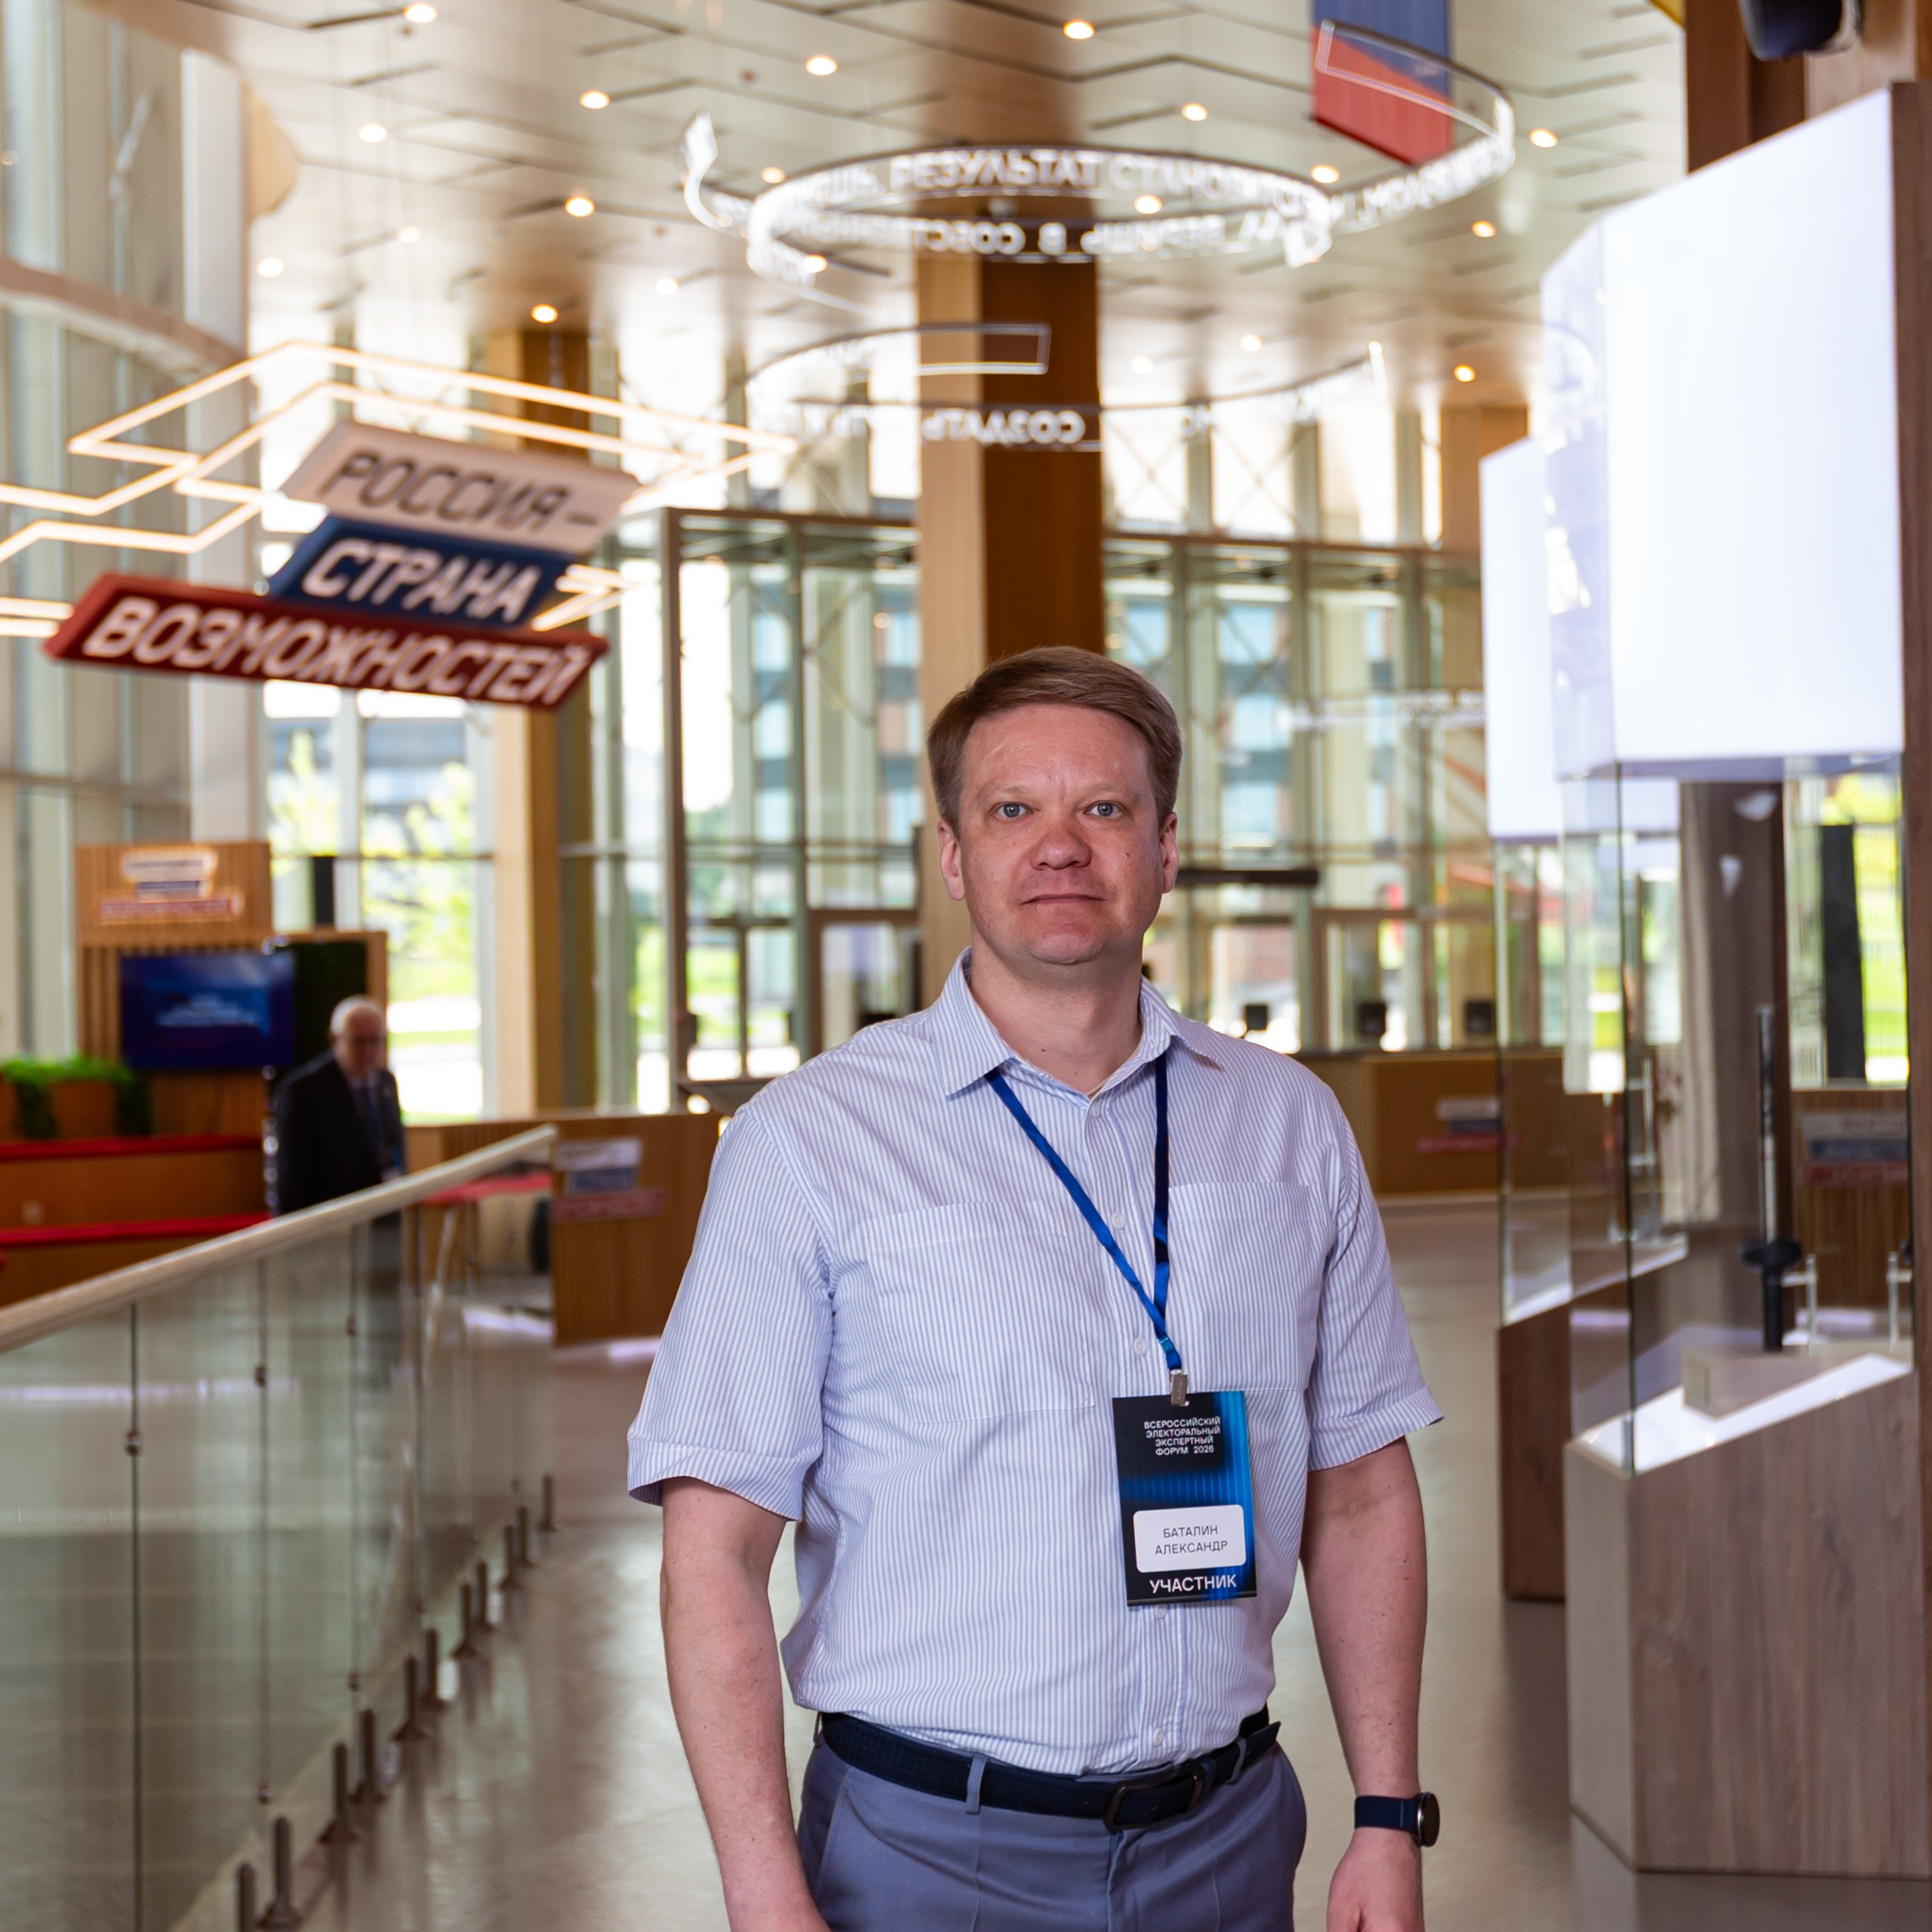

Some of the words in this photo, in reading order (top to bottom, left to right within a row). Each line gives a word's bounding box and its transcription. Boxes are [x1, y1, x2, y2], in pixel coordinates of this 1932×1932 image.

[889, 149, 1103, 189] РЕЗУЛЬТАТ
[318, 448, 572, 530] РОССИЯ
[303, 537, 543, 623] СТРАНА
[83, 597, 592, 704] ВОЗМОЖНОСТЕЙ
[1144, 1416, 1220, 1429] ВСЕРОССИЙСКИЙ
[1146, 1426, 1220, 1438] ЭЛЕКТОРАЛЬНЫЙ
[1155, 1435, 1214, 1447] ЭКСПЕРТНЫЙ
[1155, 1447, 1189, 1456] ФОРУМ
[1163, 1525, 1218, 1538] БАТАЛИН
[1155, 1540, 1228, 1555] АЛЕКСАНДР
[1149, 1574, 1237, 1594] УЧАСТНИК
